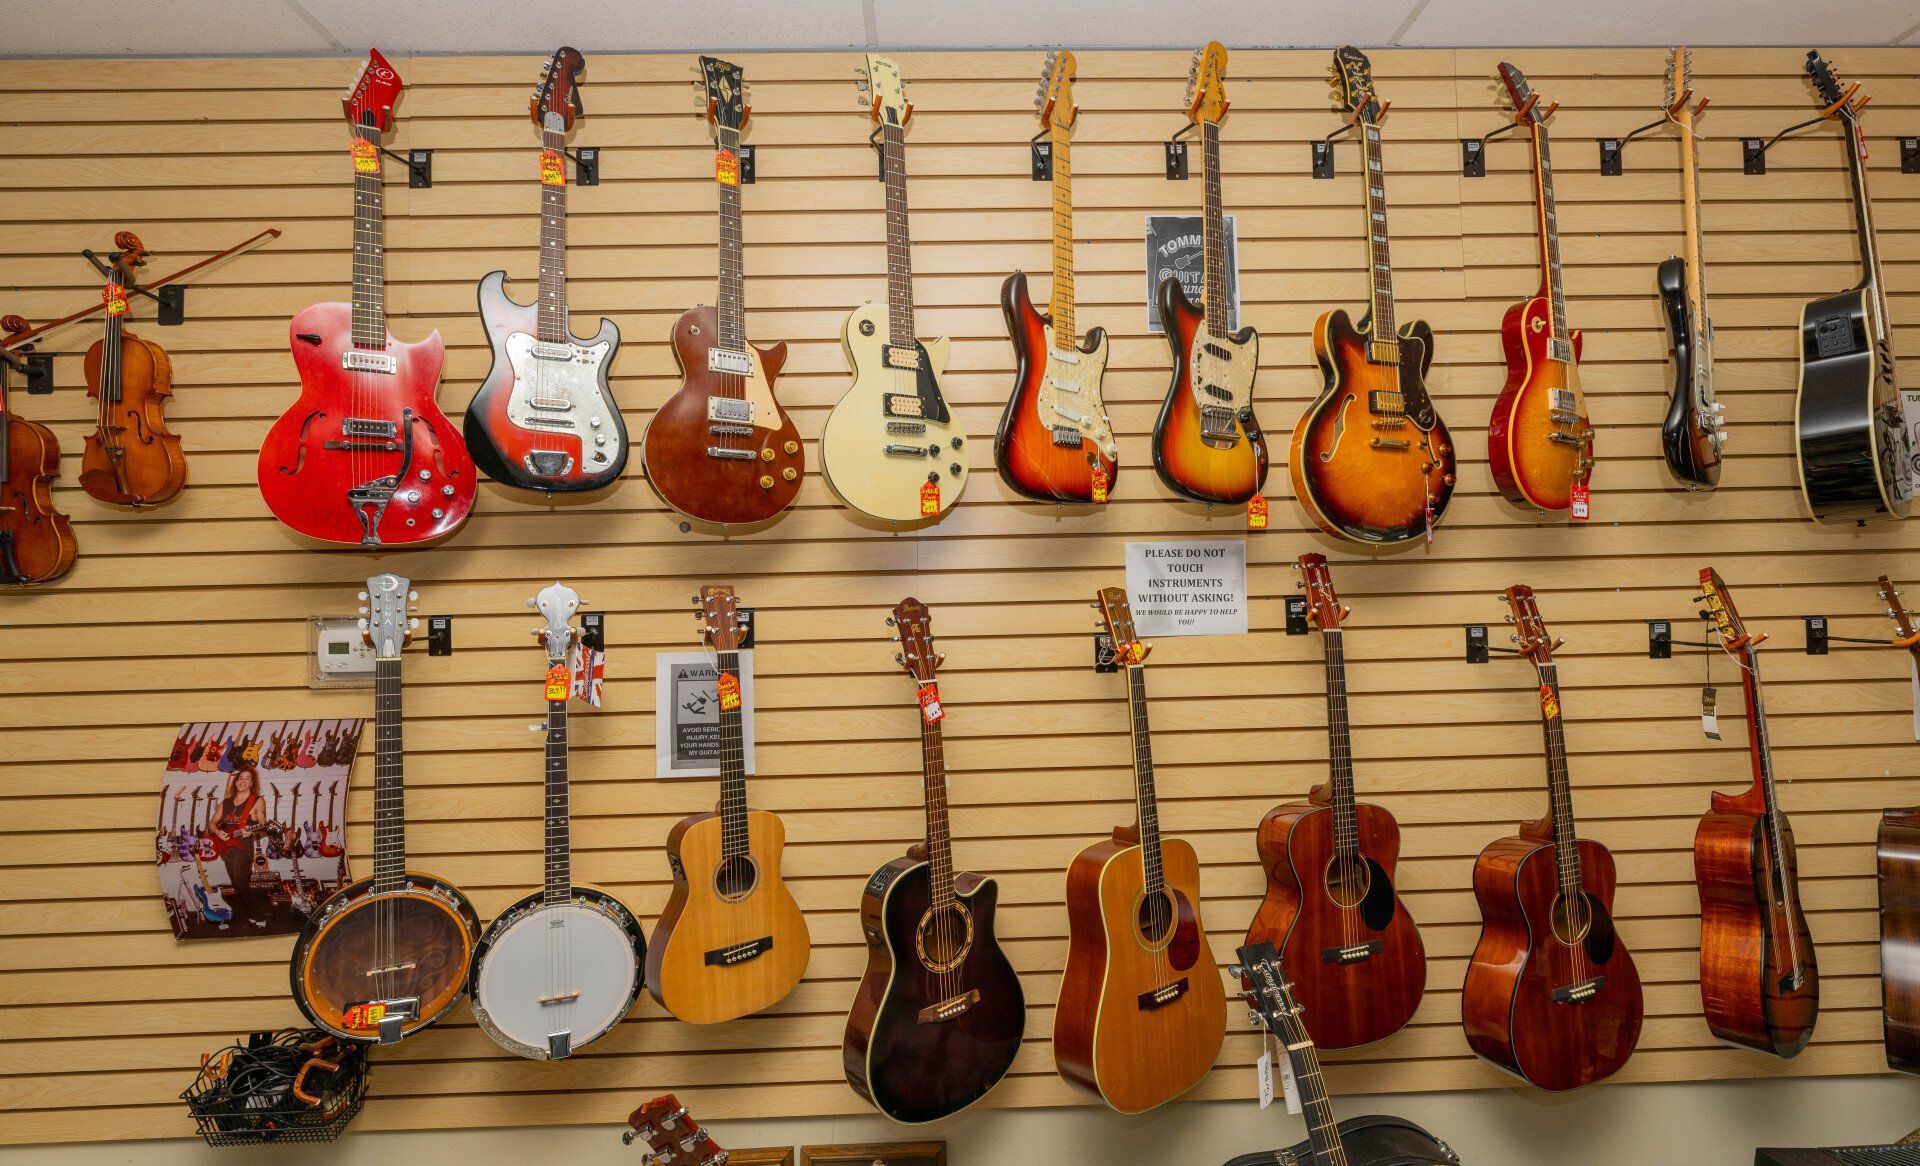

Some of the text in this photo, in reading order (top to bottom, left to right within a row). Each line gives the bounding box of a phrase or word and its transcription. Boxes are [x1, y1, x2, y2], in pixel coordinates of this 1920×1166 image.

[375, 79, 393, 87] KAY
[1158, 234, 1204, 258] TOMM
[1145, 548, 1226, 558] PLEASE DO NOT
[1167, 563, 1204, 573] TOUCH
[1148, 578, 1223, 588] INSTRUMENTS
[1138, 593, 1234, 603] WITHOUT ASKING!
[384, 593, 393, 626] LUNA
[1184, 608, 1208, 616] HAPPY
[1209, 608, 1219, 616] TO
[690, 669, 718, 677] WARN
